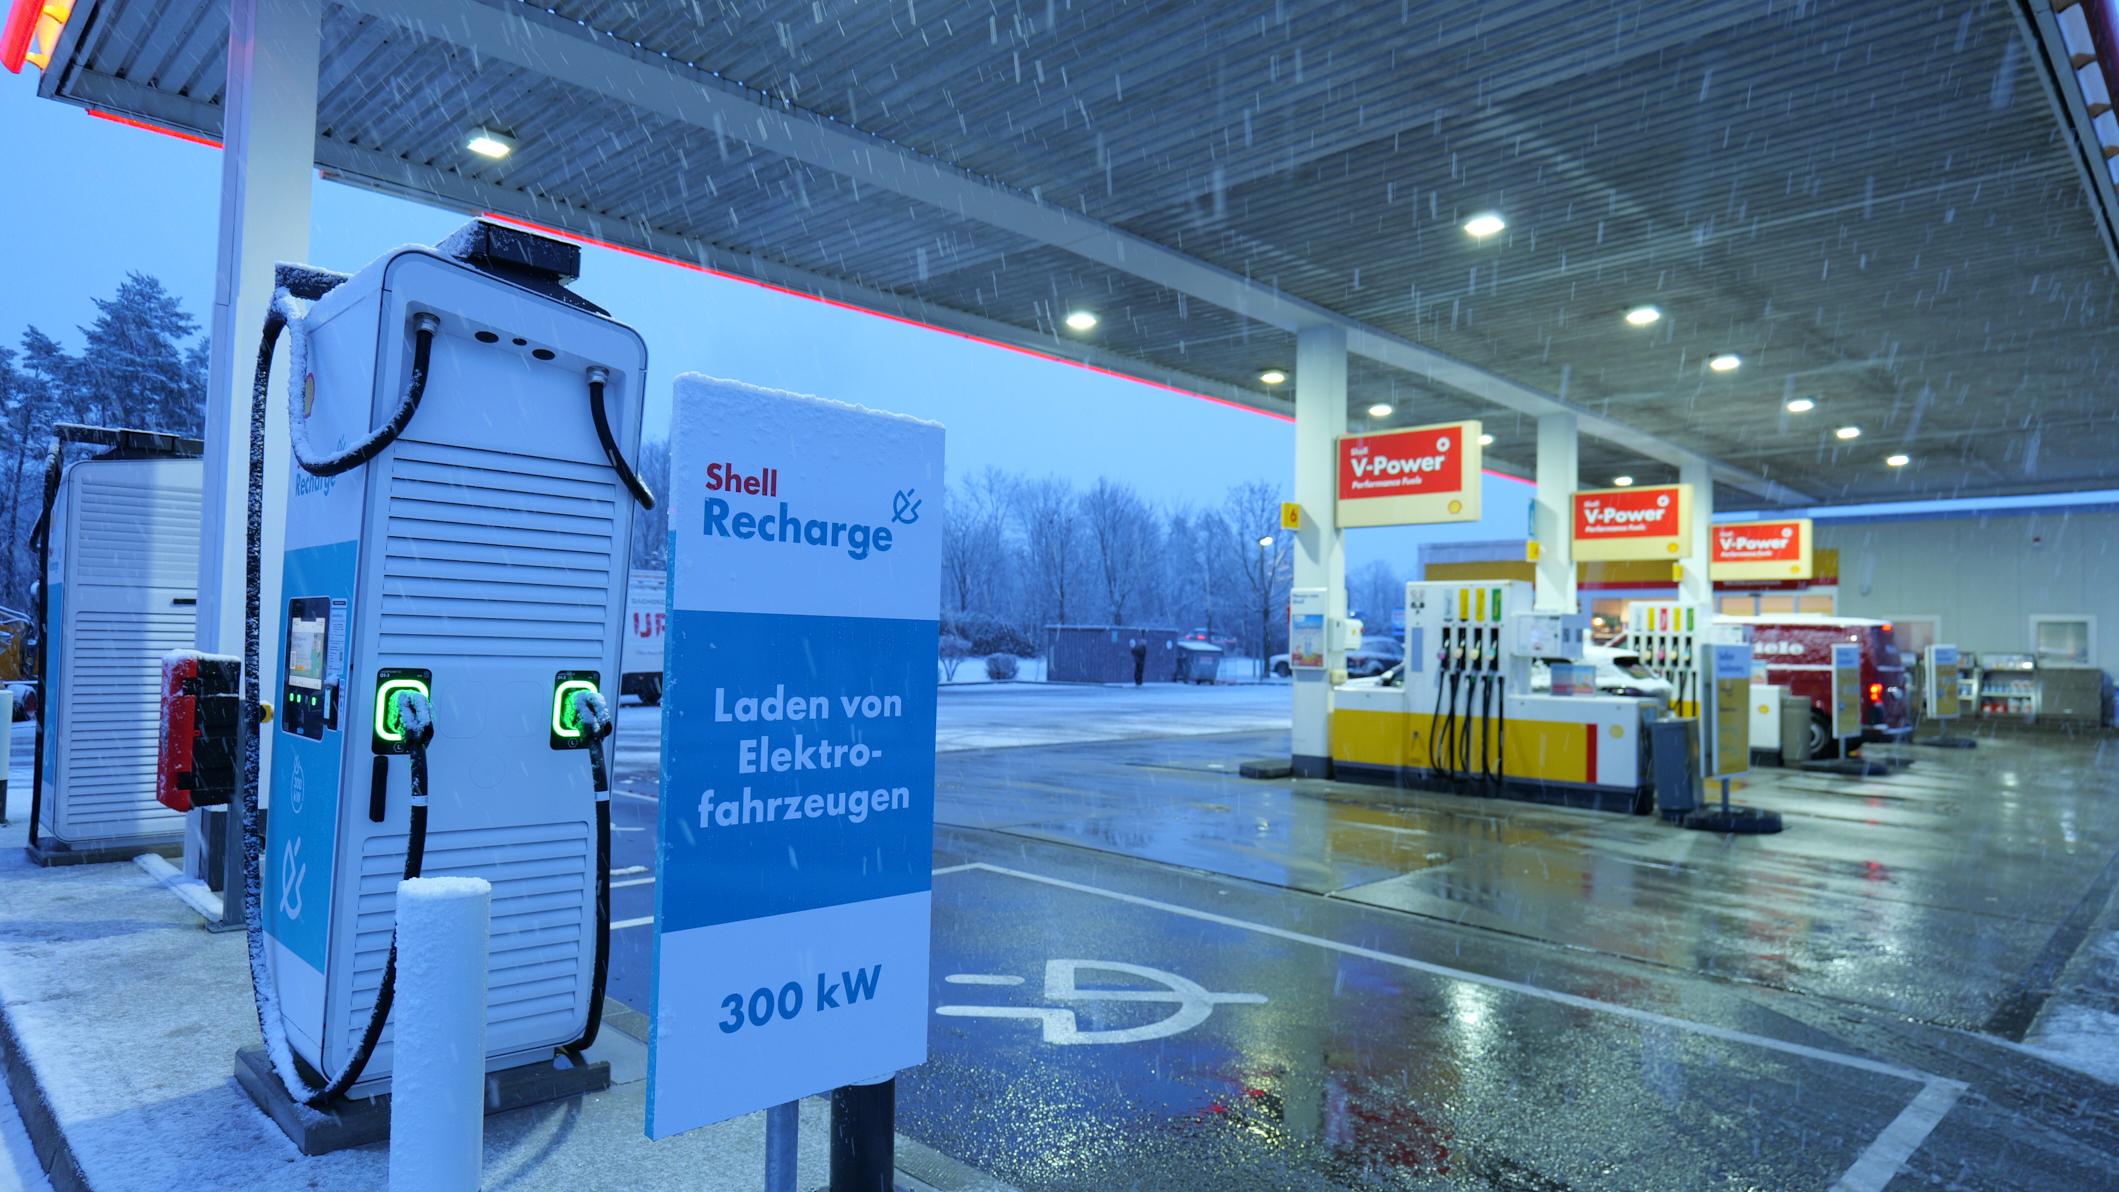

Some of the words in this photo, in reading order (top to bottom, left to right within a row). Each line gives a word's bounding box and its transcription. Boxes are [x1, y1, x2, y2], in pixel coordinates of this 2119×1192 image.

[705, 462, 777, 497] Shell
[1350, 454, 1446, 478] V-Power
[703, 497, 893, 561] Recharge
[1289, 508, 1297, 523] 6
[1583, 506, 1666, 524] V-Power
[1719, 535, 1789, 552] V-Power
[1753, 640, 1805, 656] iele
[714, 683, 830, 723] Laden
[840, 694, 902, 719] von
[738, 734, 882, 774] Elektro-
[697, 786, 910, 829] fahrzeugen
[718, 980, 804, 1034] 300
[816, 964, 882, 1012] kW
